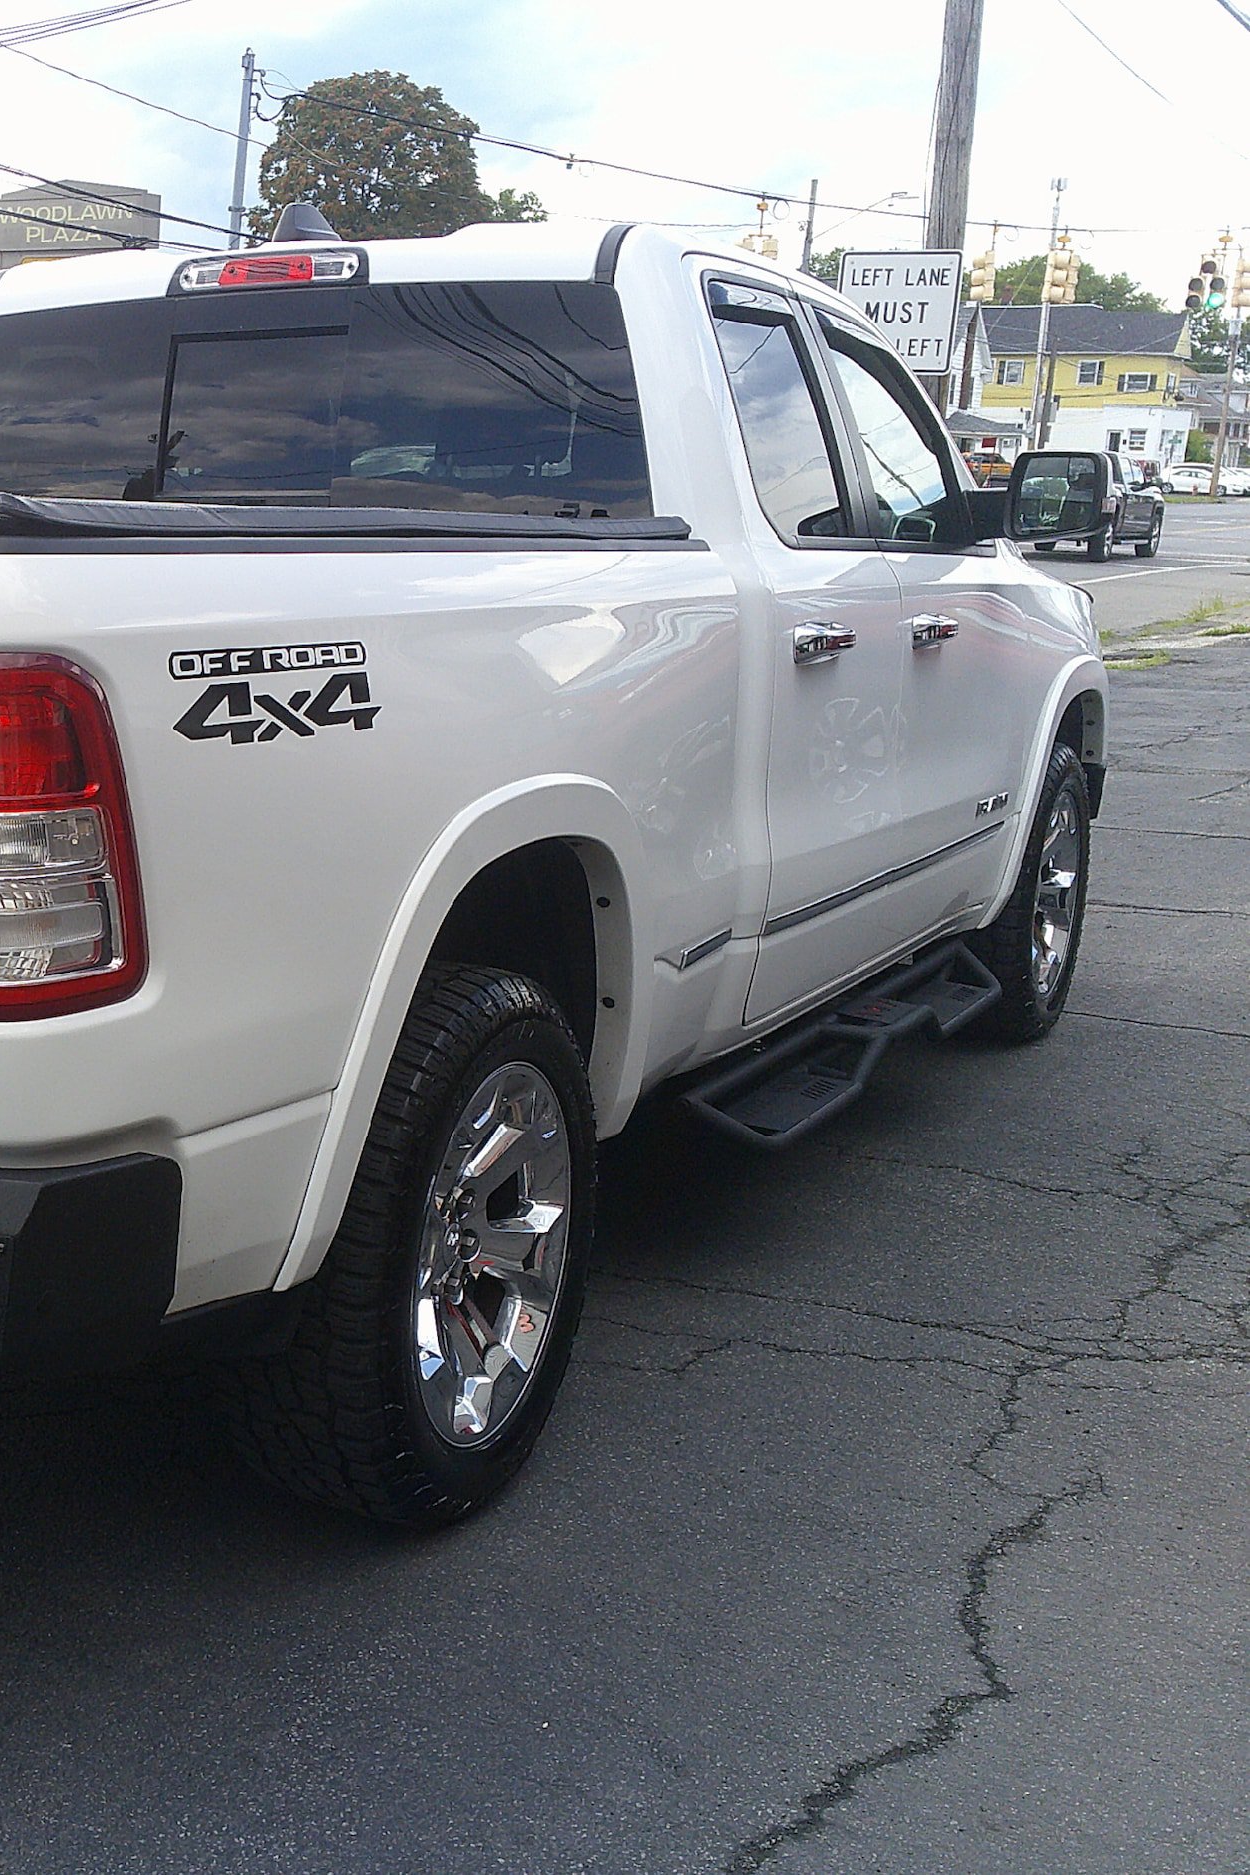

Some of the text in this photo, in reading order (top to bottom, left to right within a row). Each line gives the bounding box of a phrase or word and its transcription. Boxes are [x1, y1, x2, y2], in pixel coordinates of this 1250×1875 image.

[0, 203, 133, 224] WOODLAWN
[26, 226, 102, 243] PLAZA
[851, 268, 951, 287] LEFT LANE
[865, 301, 929, 324] MUST
[896, 338, 943, 357] LEFT
[171, 645, 365, 677] OFF ROAD
